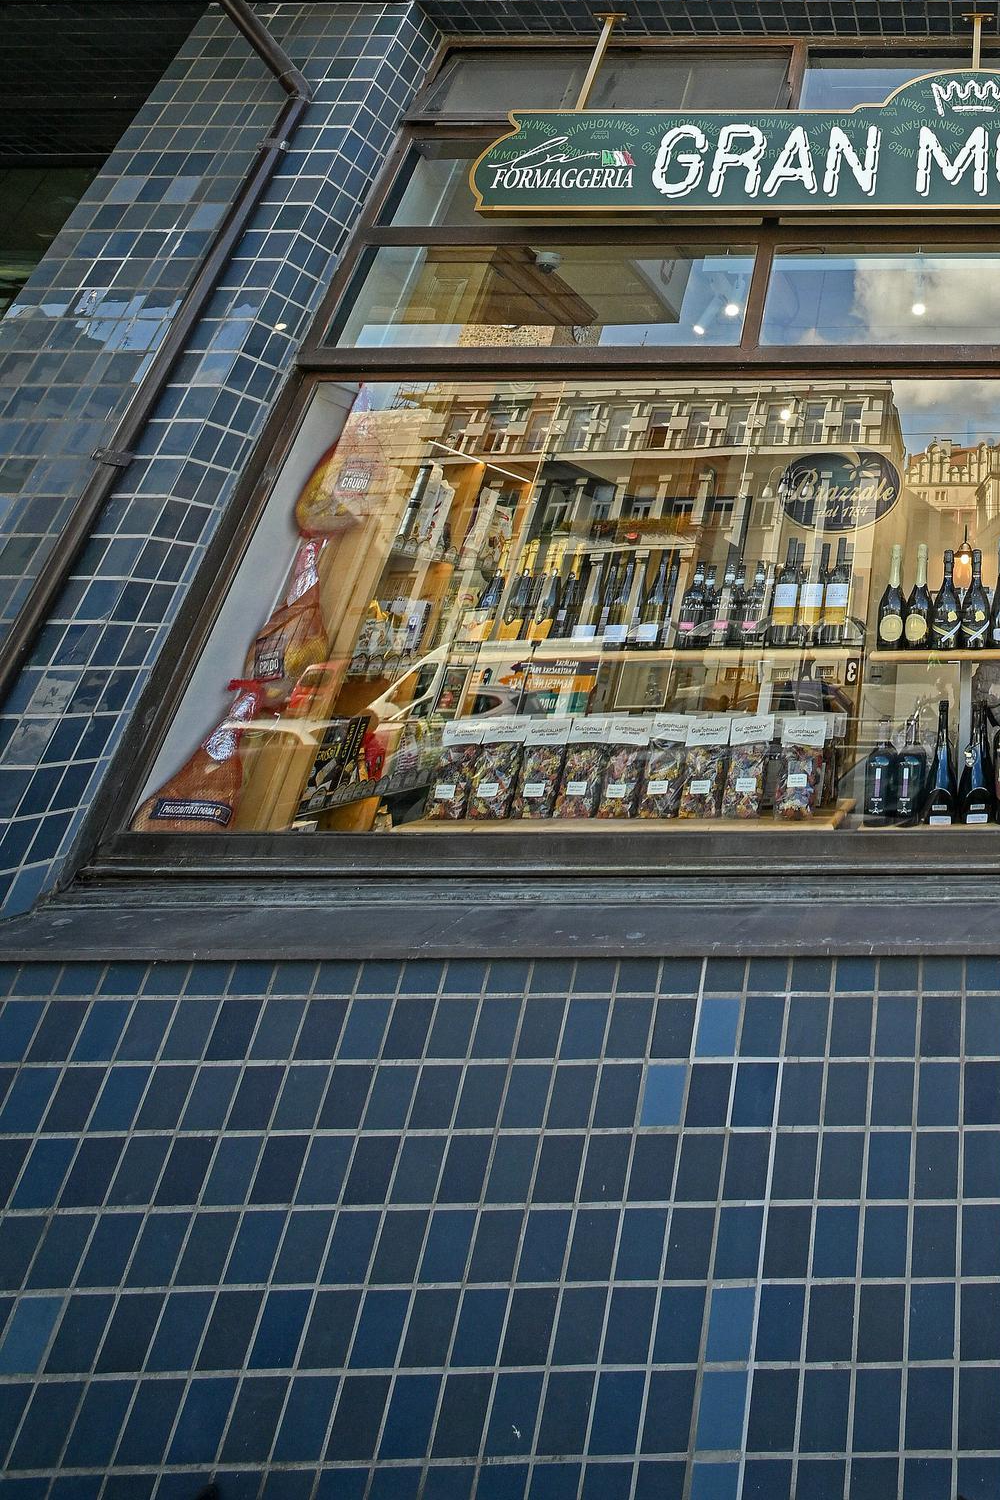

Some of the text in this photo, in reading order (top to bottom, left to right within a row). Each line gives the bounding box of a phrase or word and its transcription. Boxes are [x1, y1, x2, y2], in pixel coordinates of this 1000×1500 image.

[652, 124, 881, 198] GRAN
[490, 168, 634, 189] FORMAGGERIA
[341, 477, 369, 489] CRUDO
[785, 468, 896, 504] Brazzale
